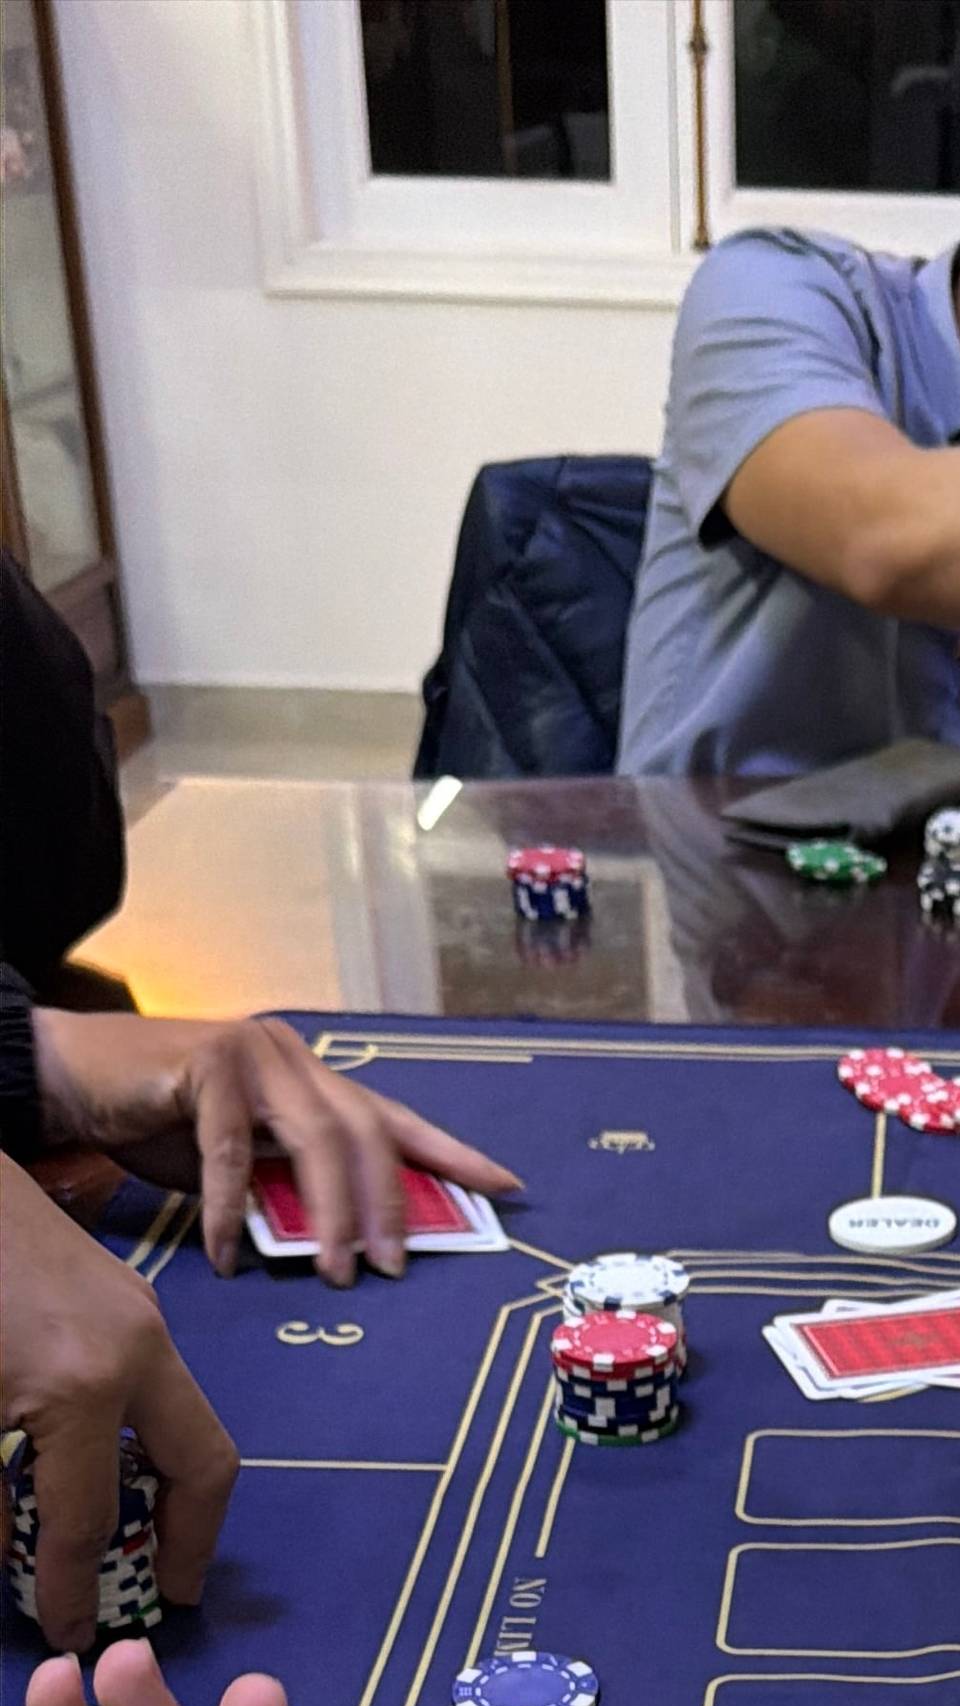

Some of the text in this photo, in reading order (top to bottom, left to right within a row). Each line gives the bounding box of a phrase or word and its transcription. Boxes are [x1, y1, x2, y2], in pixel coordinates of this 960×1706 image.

[848, 1217, 941, 1229] DEALER
[277, 1320, 364, 1346] 3
[509, 1577, 547, 1609] NO
[494, 1616, 537, 1657] LIM
